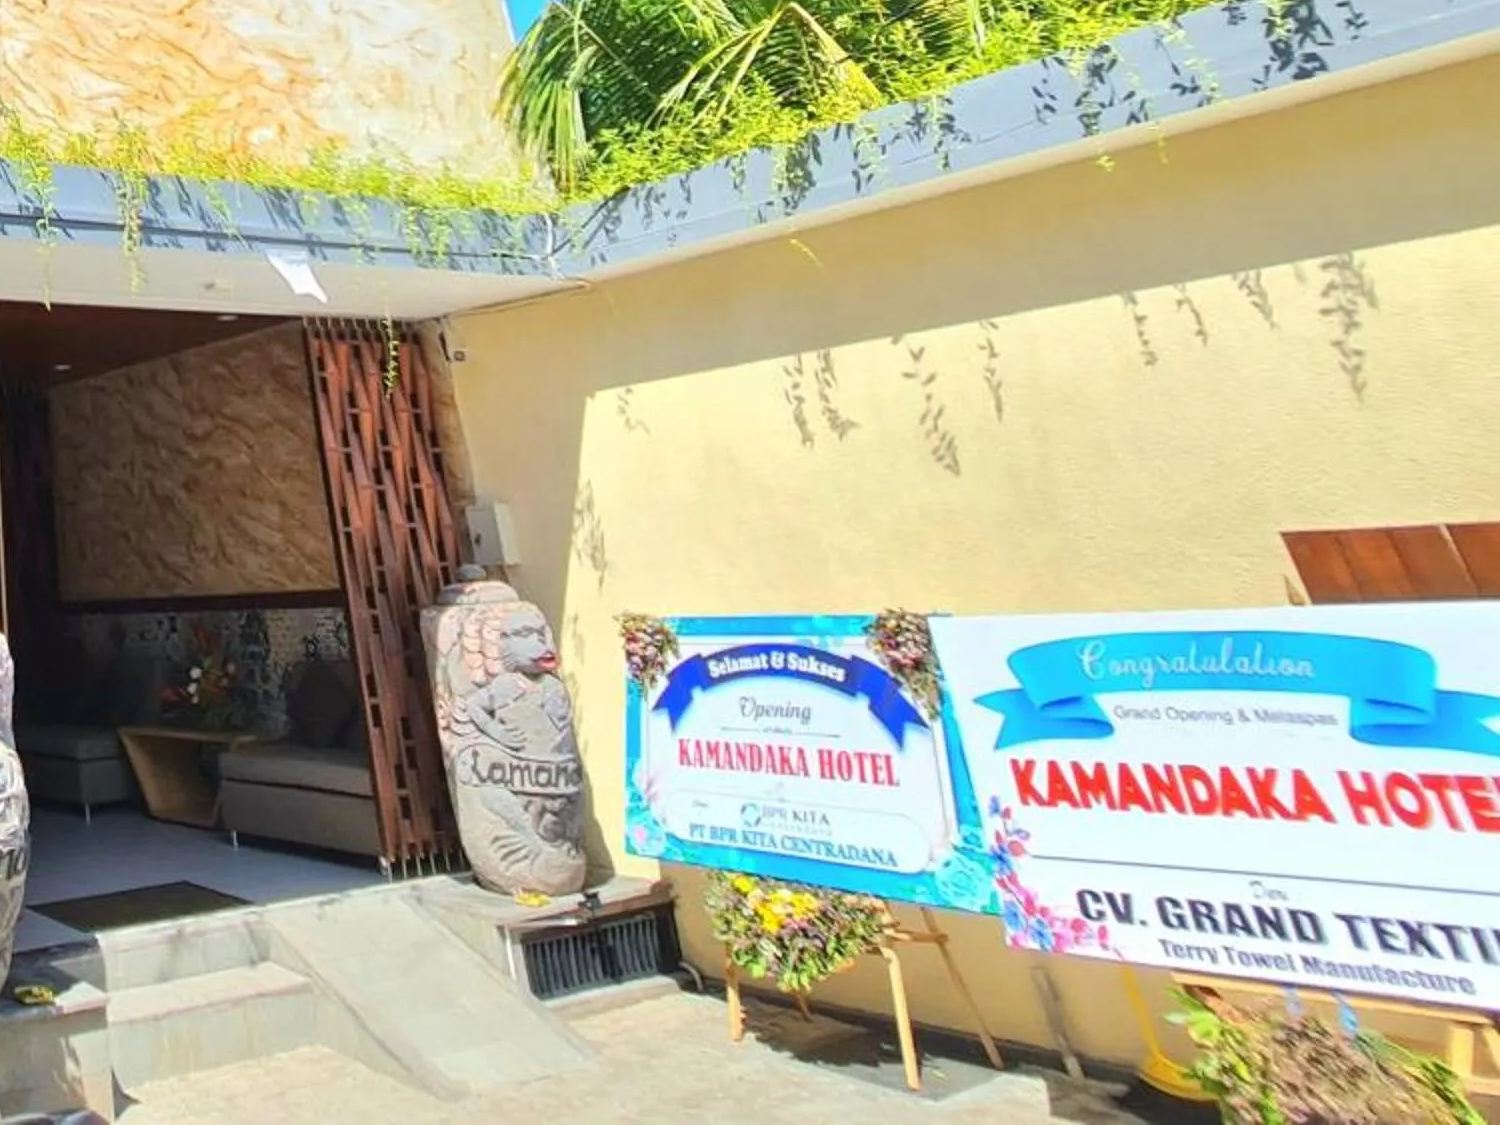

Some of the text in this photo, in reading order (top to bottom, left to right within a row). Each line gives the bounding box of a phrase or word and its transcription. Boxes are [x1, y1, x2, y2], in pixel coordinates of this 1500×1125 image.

[707, 650, 846, 682] Selamat & Sukses
[1077, 636, 1316, 688] Congratulation
[739, 696, 812, 725] Opening
[1113, 704, 1161, 722] Grand
[1165, 705, 1234, 725] Opening
[1238, 708, 1250, 723] &
[678, 737, 900, 787] KAMANDAKA HOTEL
[792, 810, 831, 826] KITA
[1010, 758, 1500, 833] KAMANDAKA HOTE
[689, 824, 706, 840] PT
[741, 830, 778, 850] KITA
[780, 835, 898, 868] CENTRADANA
[1076, 888, 1500, 966] CV. GRAND TEXTI
[1158, 938, 1477, 996] Terry Towel Manufacture
